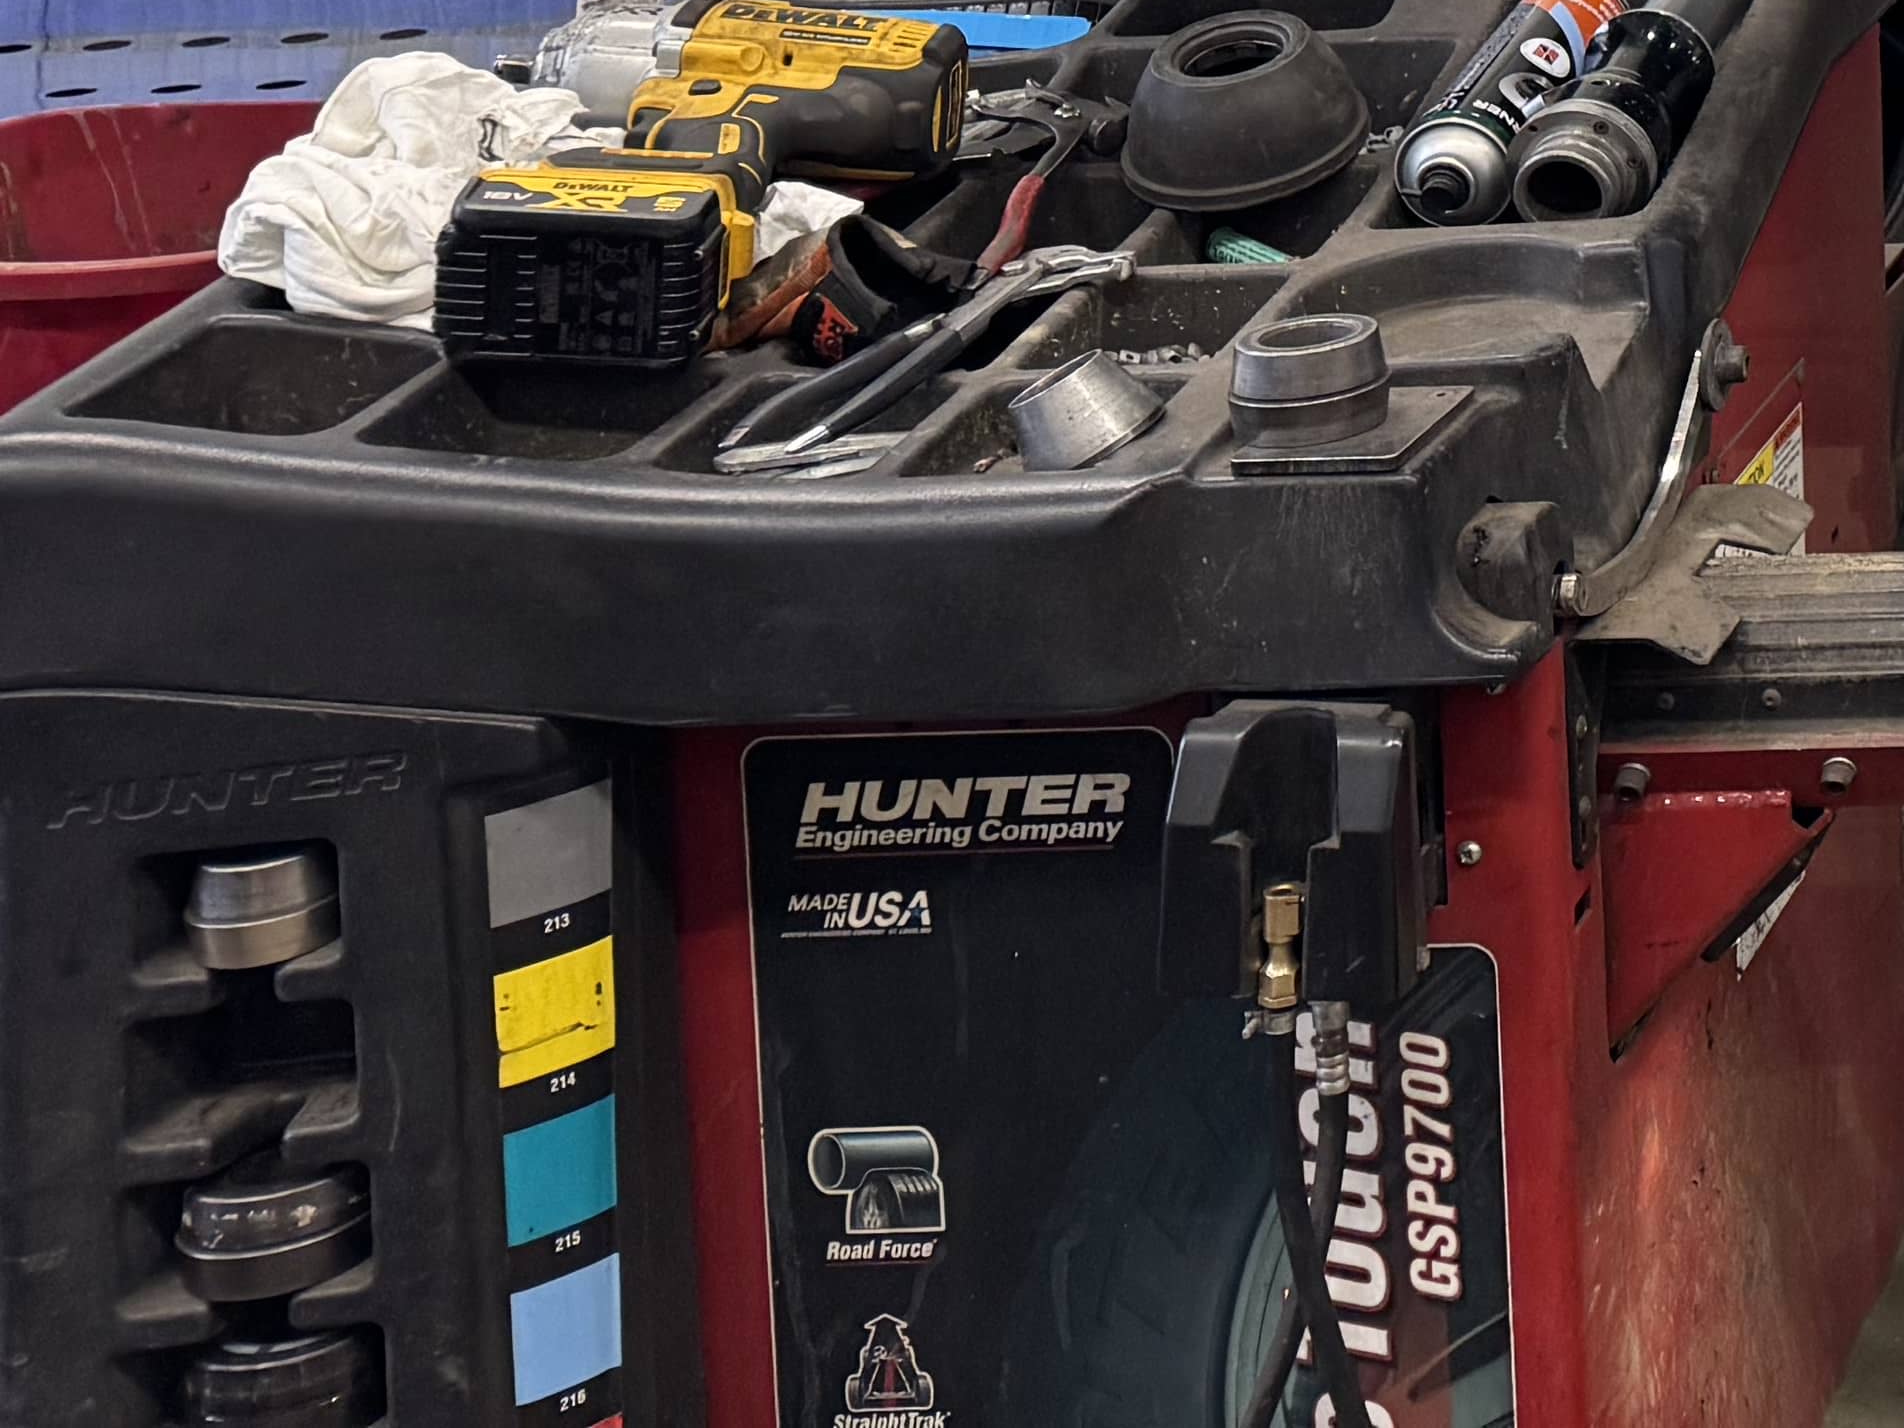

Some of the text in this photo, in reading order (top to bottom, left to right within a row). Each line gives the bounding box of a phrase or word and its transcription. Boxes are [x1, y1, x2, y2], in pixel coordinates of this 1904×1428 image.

[45, 750, 409, 830] HUNTER
[800, 773, 1131, 824] HUNTER
[796, 818, 1124, 852] Engineering Company
[543, 914, 571, 934] 213
[788, 890, 931, 929] MADE IN USA
[550, 1073, 577, 1093] 214
[1400, 1030, 1462, 1301] GSP9700
[554, 1231, 583, 1252] 215
[826, 1241, 874, 1261] Road
